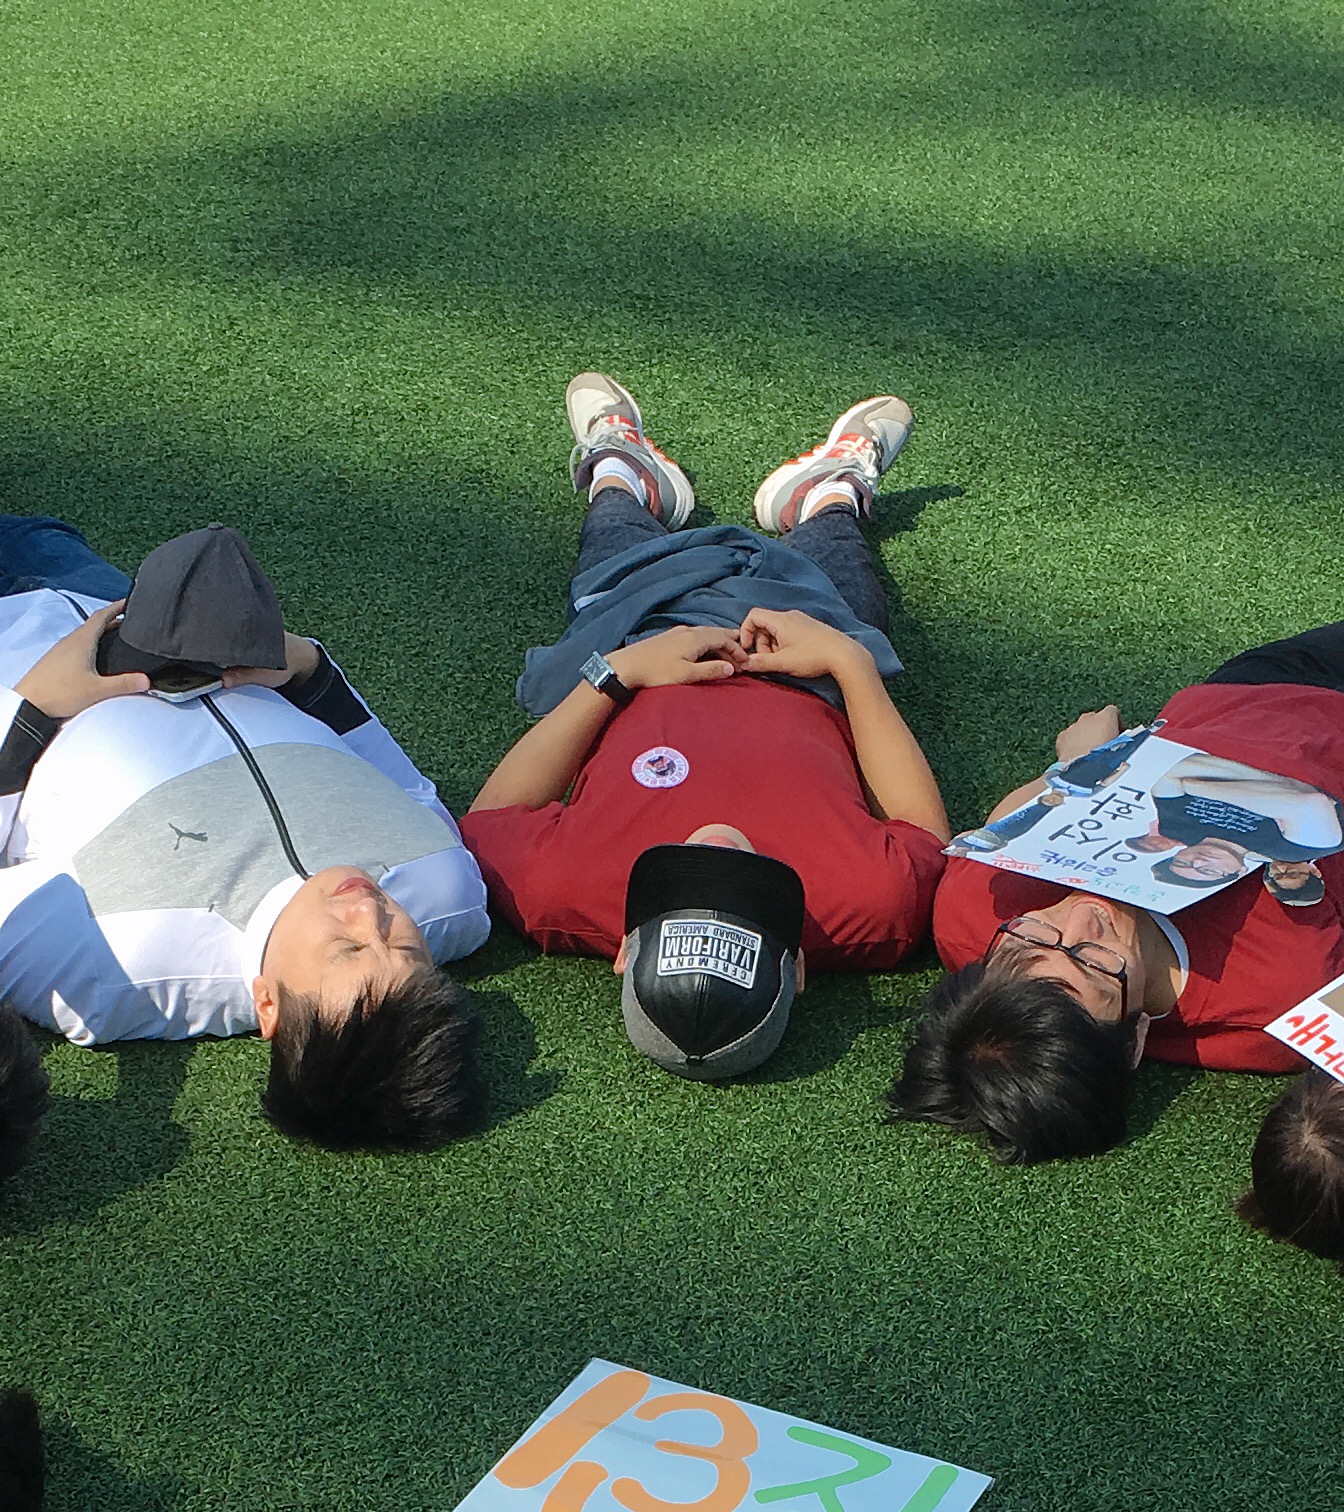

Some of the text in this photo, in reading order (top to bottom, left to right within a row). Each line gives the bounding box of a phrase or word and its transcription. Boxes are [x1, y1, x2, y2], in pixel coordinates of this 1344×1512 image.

[1040, 850, 1118, 876] 승리하는
[667, 923, 757, 948] STANDARD AMERICA
[665, 936, 755, 972] VARIFORM
[664, 955, 748, 981] CEREMONY
